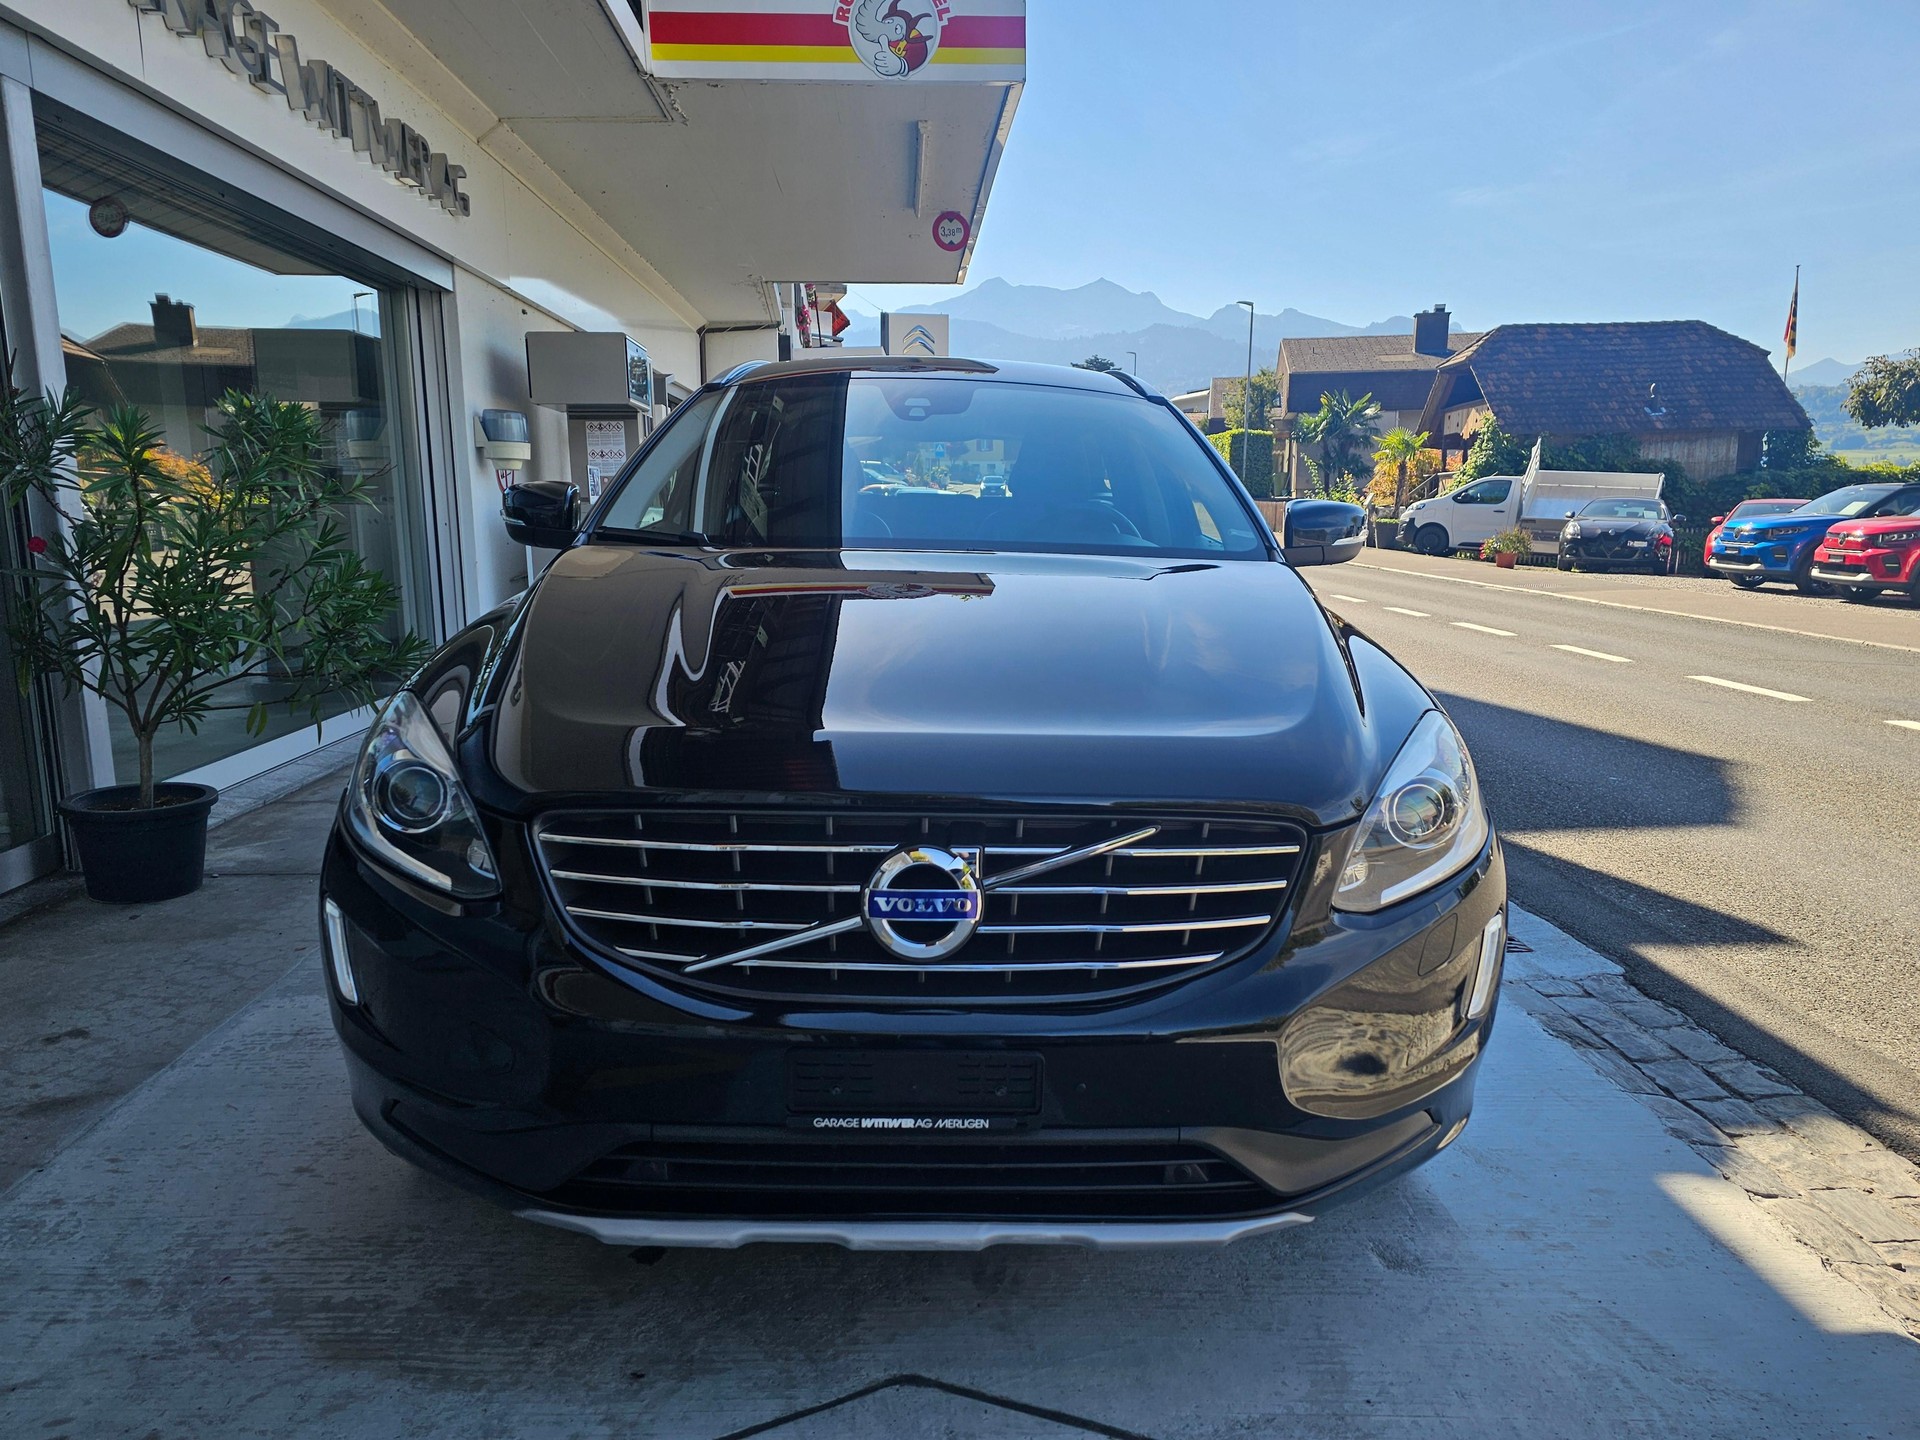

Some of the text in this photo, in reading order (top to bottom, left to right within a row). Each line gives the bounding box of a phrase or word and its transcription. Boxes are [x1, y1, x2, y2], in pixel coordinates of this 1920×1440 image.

[428, 152, 471, 218] AG
[874, 897, 972, 913] VOLVO
[813, 1117, 860, 1128] GARAGE
[860, 1118, 914, 1129] WITTWER
[915, 1118, 933, 1129] AG
